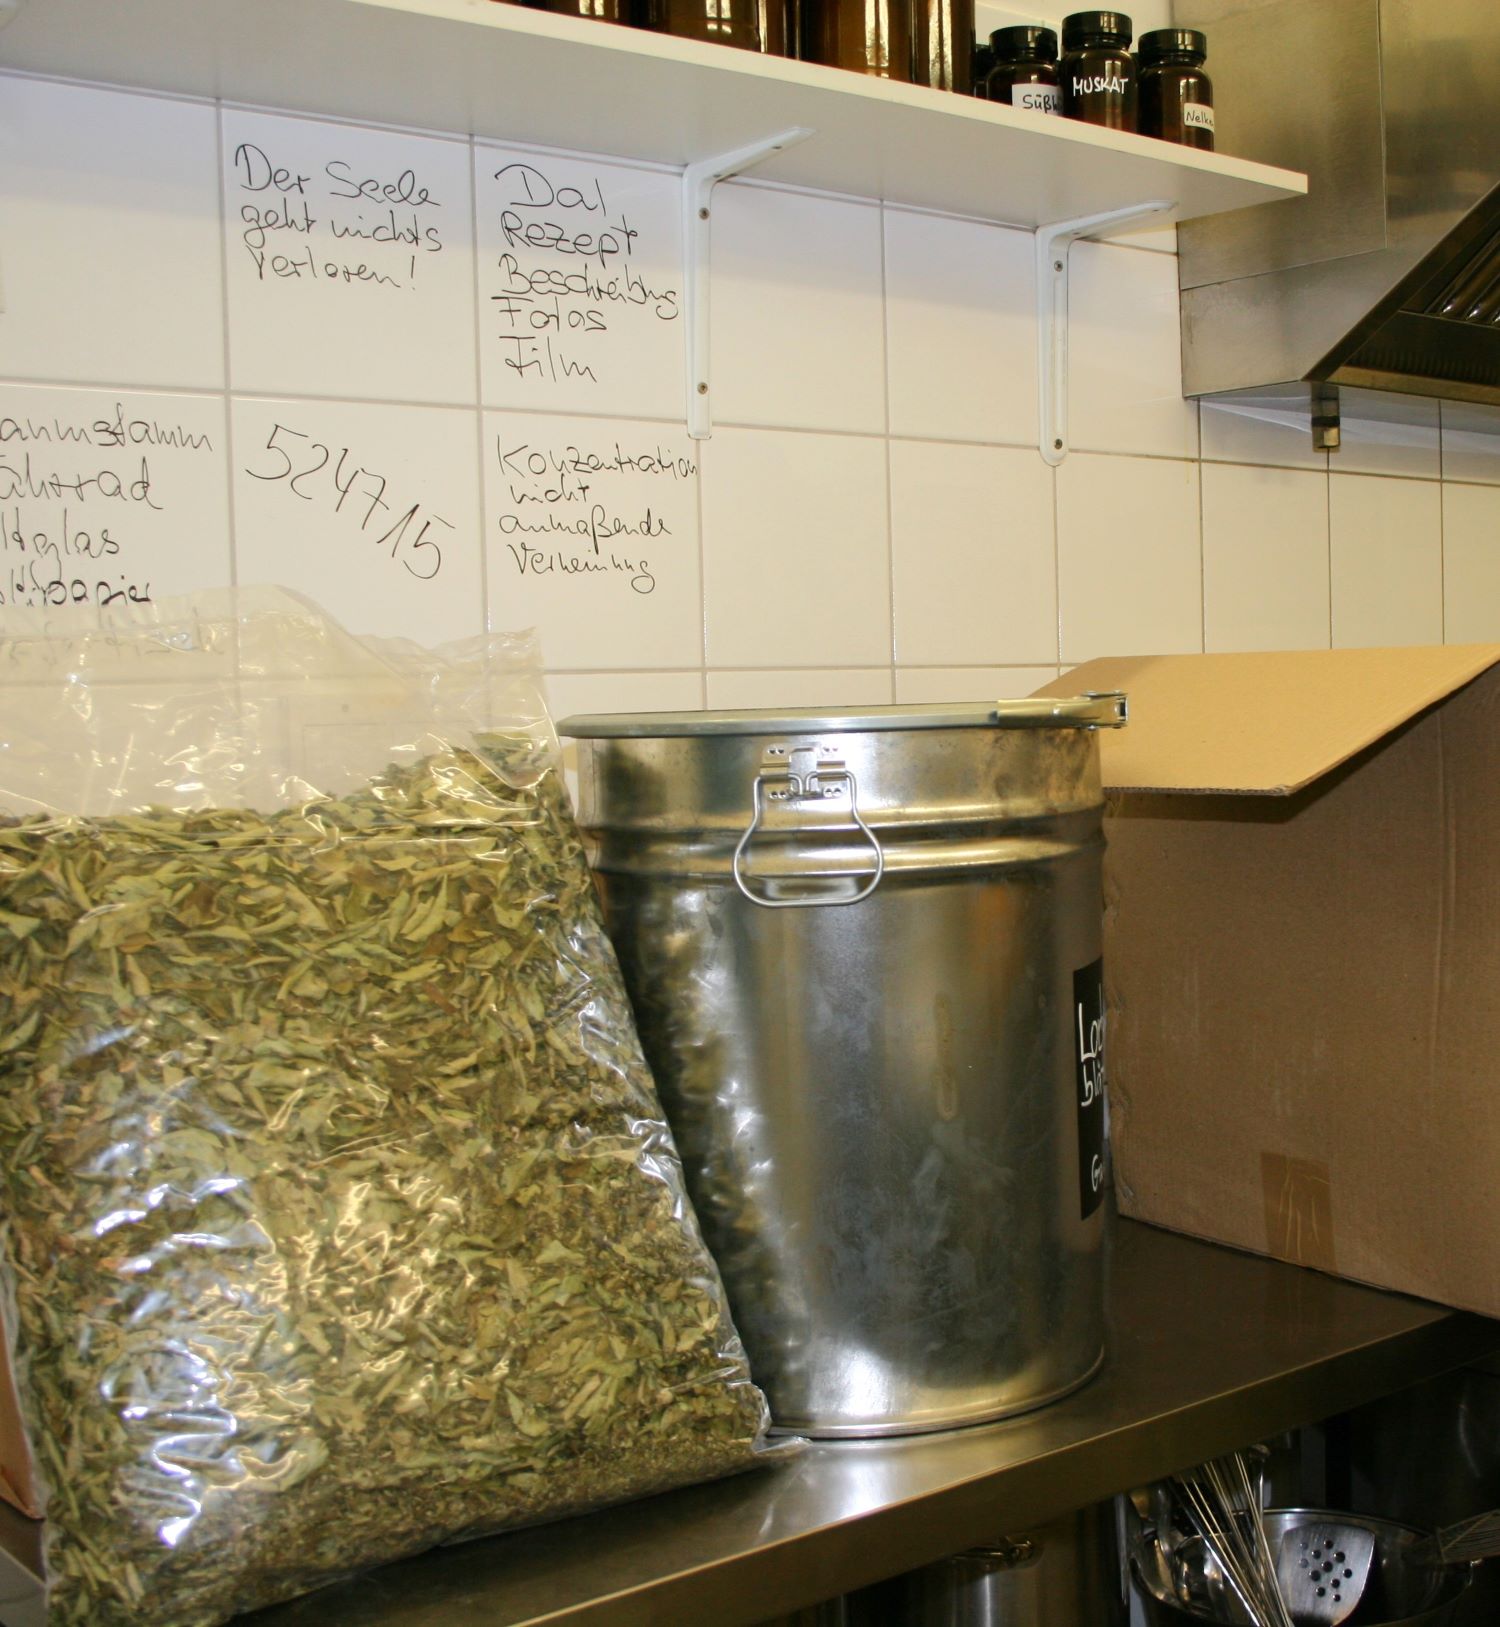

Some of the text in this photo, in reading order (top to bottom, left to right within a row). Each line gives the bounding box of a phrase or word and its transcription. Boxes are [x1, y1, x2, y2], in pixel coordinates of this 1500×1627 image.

[1022, 94, 1062, 114] Süßh
[1072, 76, 1129, 97] MUSKAT
[235, 143, 441, 207] Der Seele
[494, 163, 607, 217] Dal
[240, 197, 443, 252] geht nichts
[500, 210, 639, 270] Rezept
[498, 336, 599, 384] Film
[497, 434, 699, 481] Konzentration
[510, 473, 591, 505] nicht
